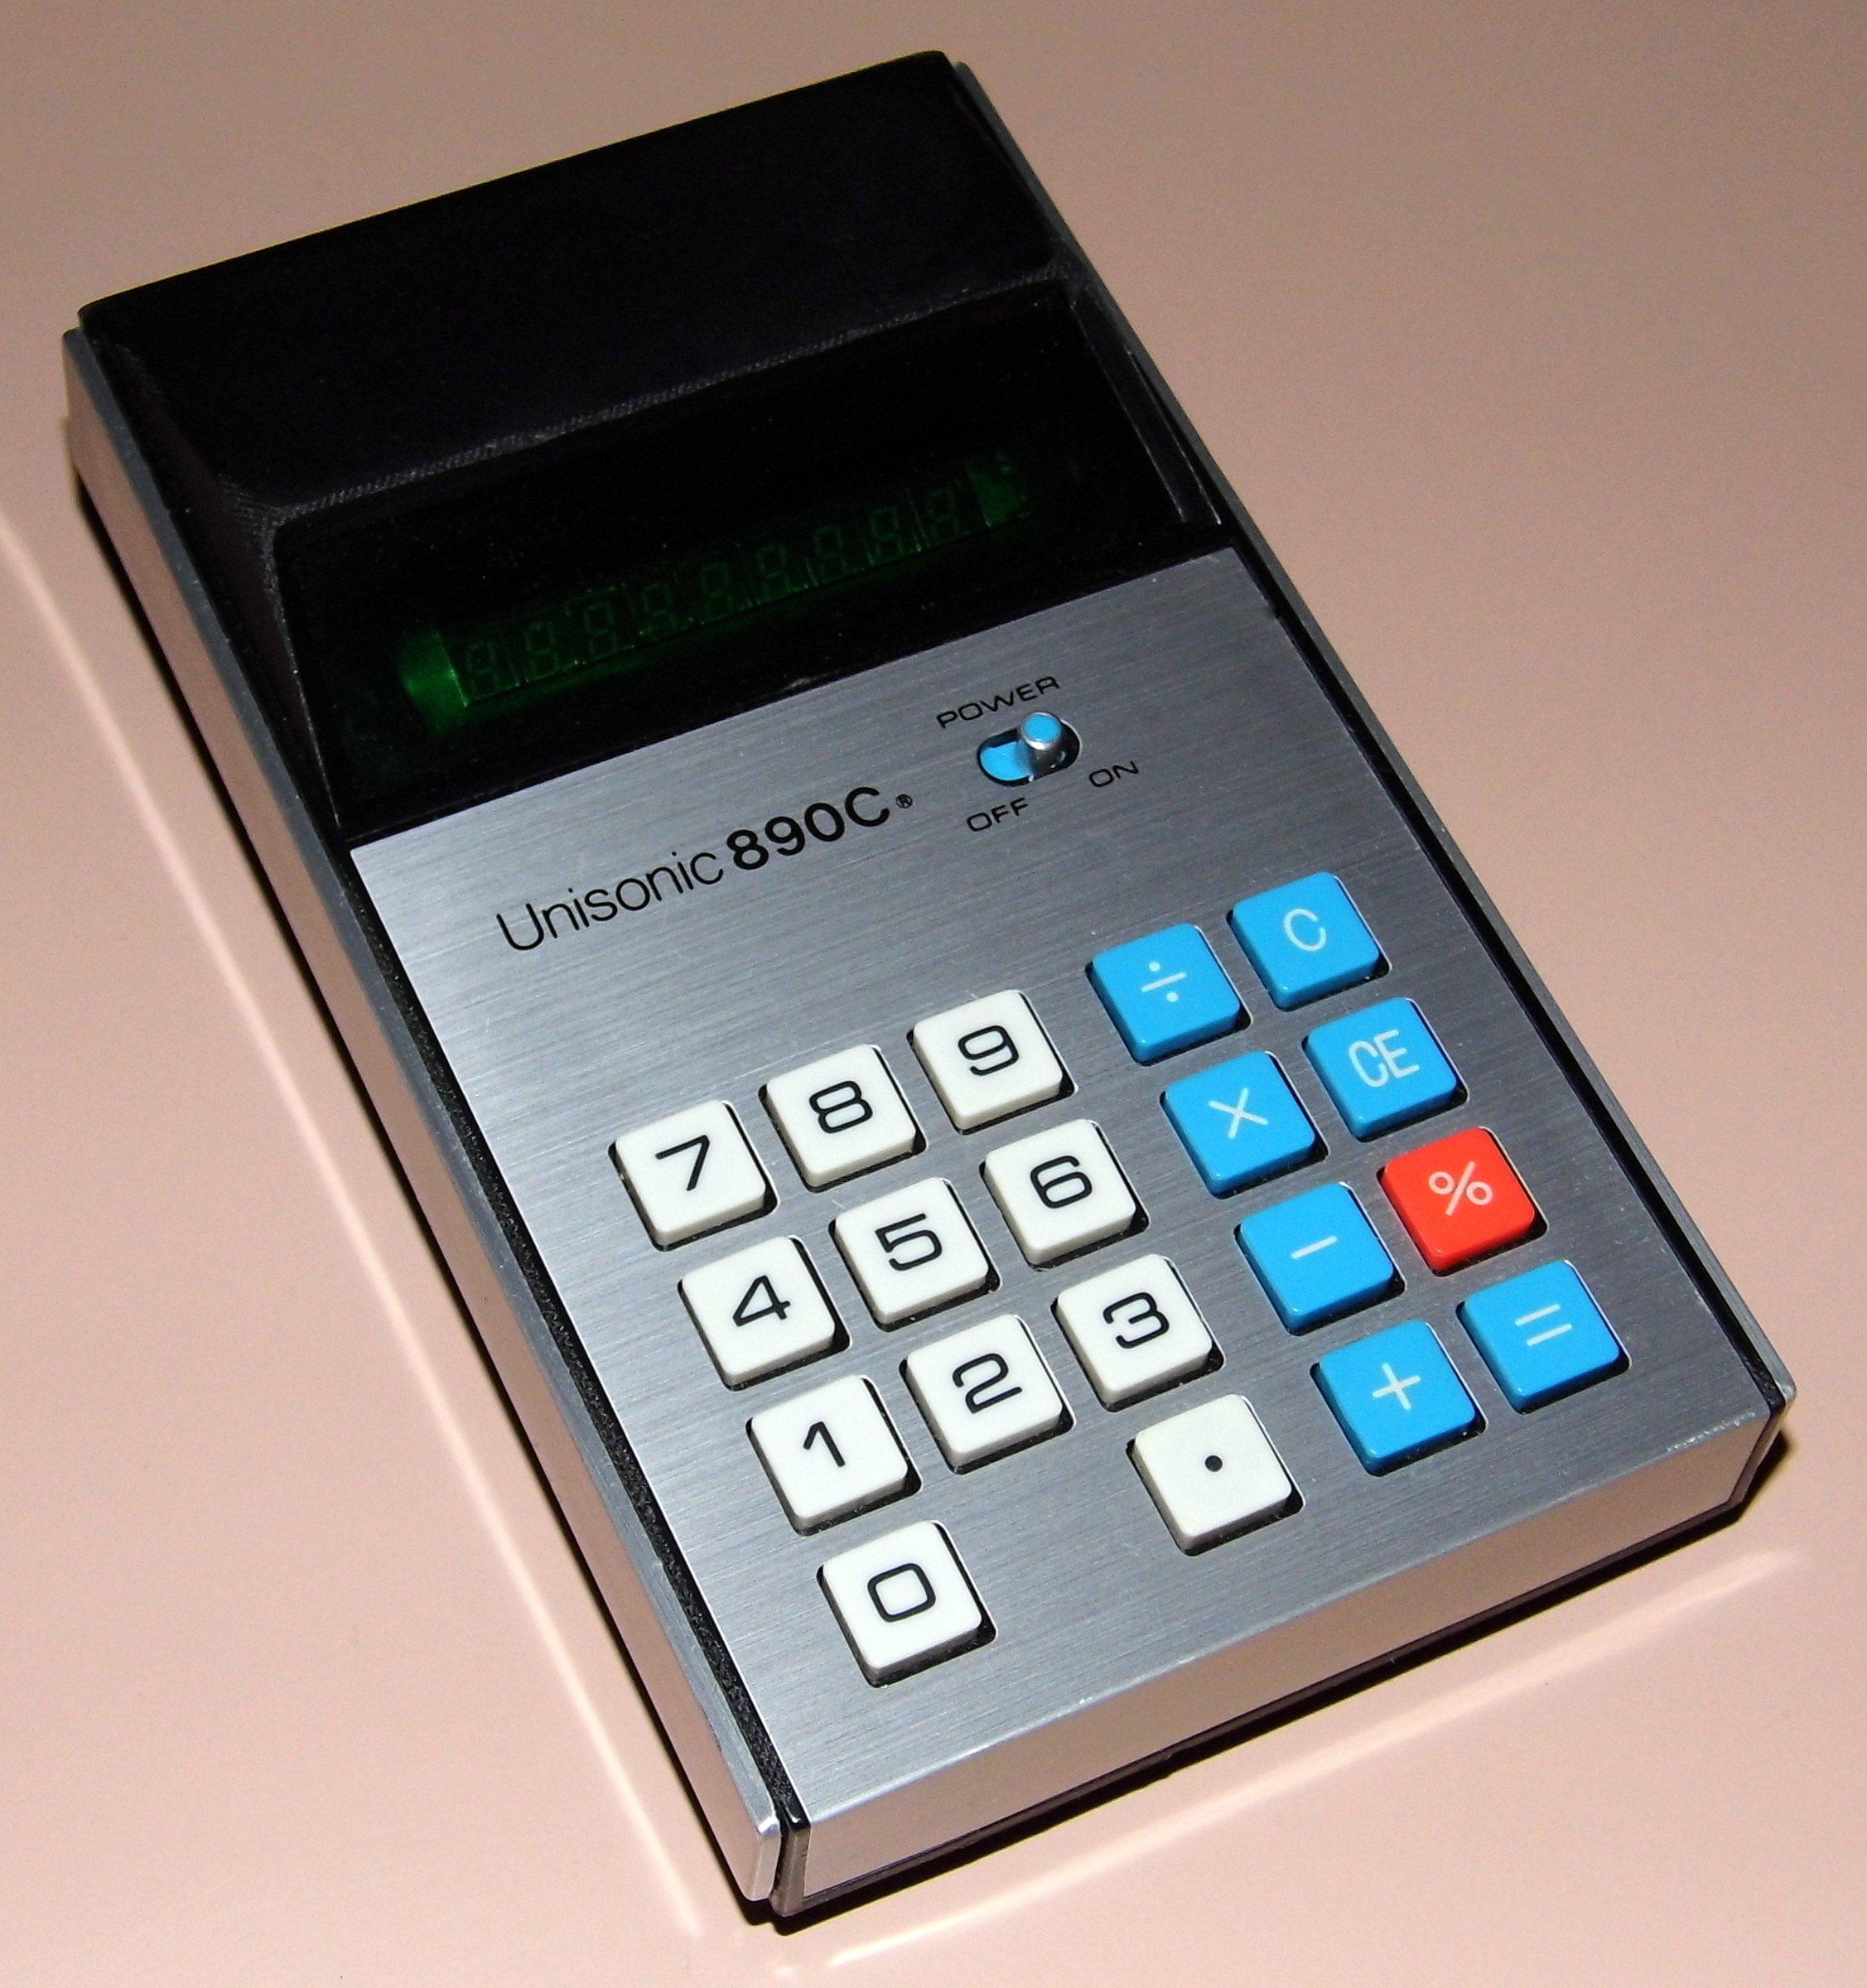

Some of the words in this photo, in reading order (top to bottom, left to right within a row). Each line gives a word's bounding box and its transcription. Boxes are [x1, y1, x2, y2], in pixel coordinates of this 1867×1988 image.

[936, 675, 1060, 728] POWER
[1088, 760, 1139, 789] ON
[966, 796, 1029, 832] OFF
[496, 851, 724, 951] Unisonic
[1285, 909, 1325, 951] C
[958, 1025, 1020, 1077] 9
[1348, 1030, 1420, 1087] CE
[808, 1080, 873, 1134] 8
[655, 1134, 711, 1192] 7
[1030, 1155, 1093, 1209] 6
[1428, 1160, 1493, 1216] %
[875, 1213, 943, 1271] 5
[732, 1275, 791, 1327] 4
[1102, 1291, 1170, 1349] 3
[952, 1353, 1023, 1414] 2
[803, 1421, 846, 1468] 1
[866, 1562, 937, 1623] 0
